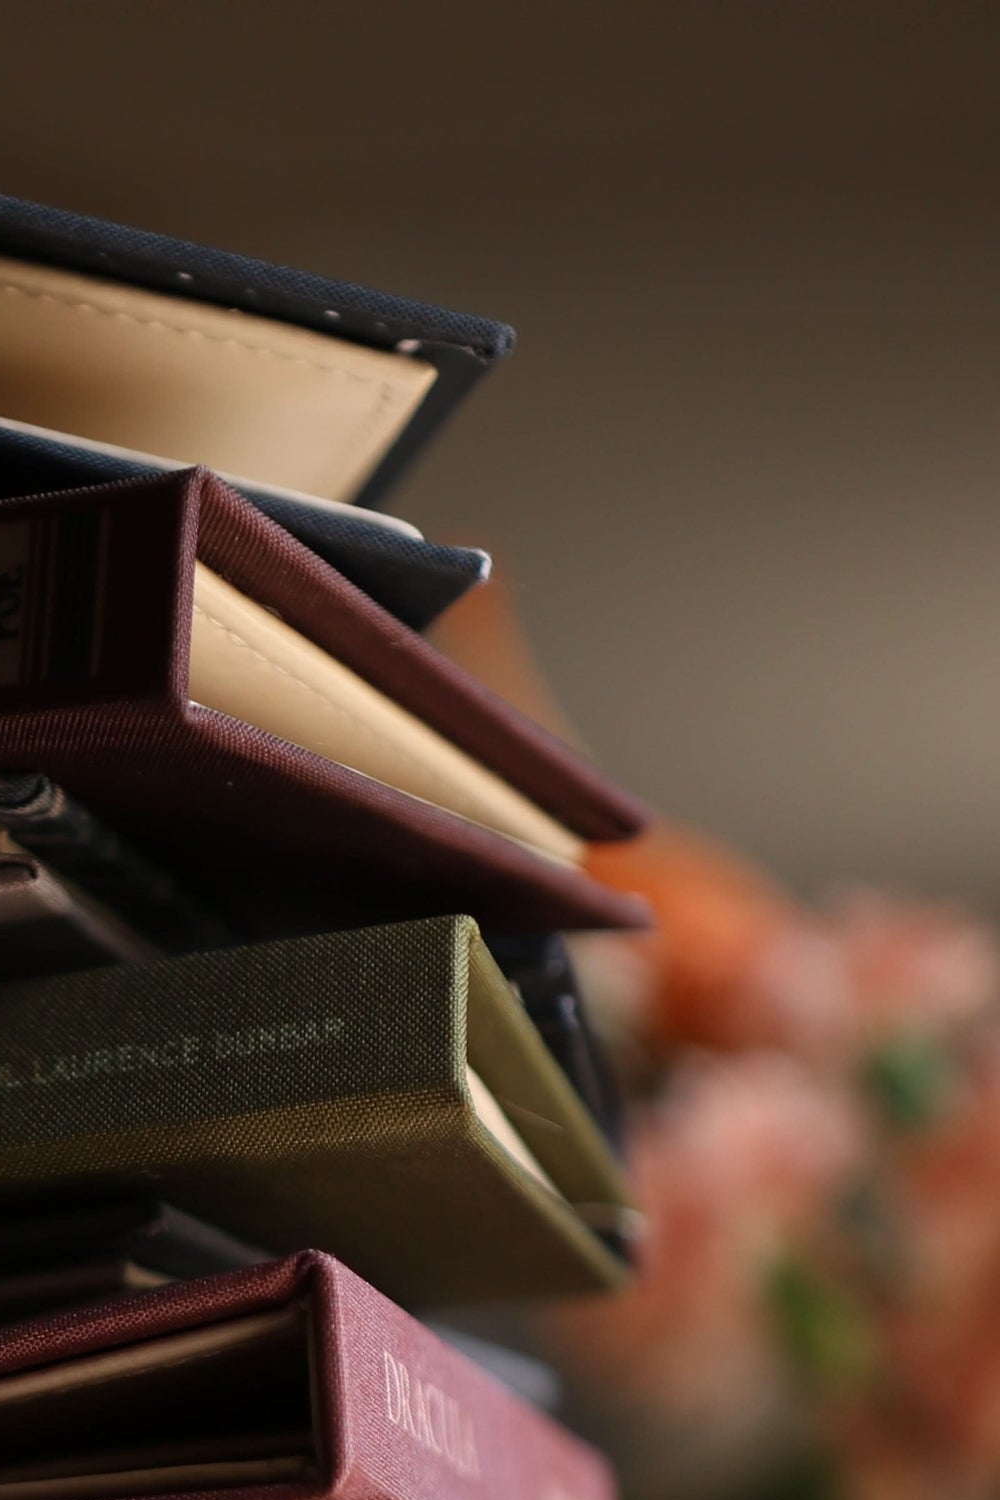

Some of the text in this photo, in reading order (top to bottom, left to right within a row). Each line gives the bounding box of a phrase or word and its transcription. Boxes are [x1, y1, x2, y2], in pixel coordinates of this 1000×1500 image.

[30, 1036, 201, 1086] LAURENCE
[211, 1014, 347, 1061] DUNBAR
[382, 1348, 482, 1482] DRACULA
